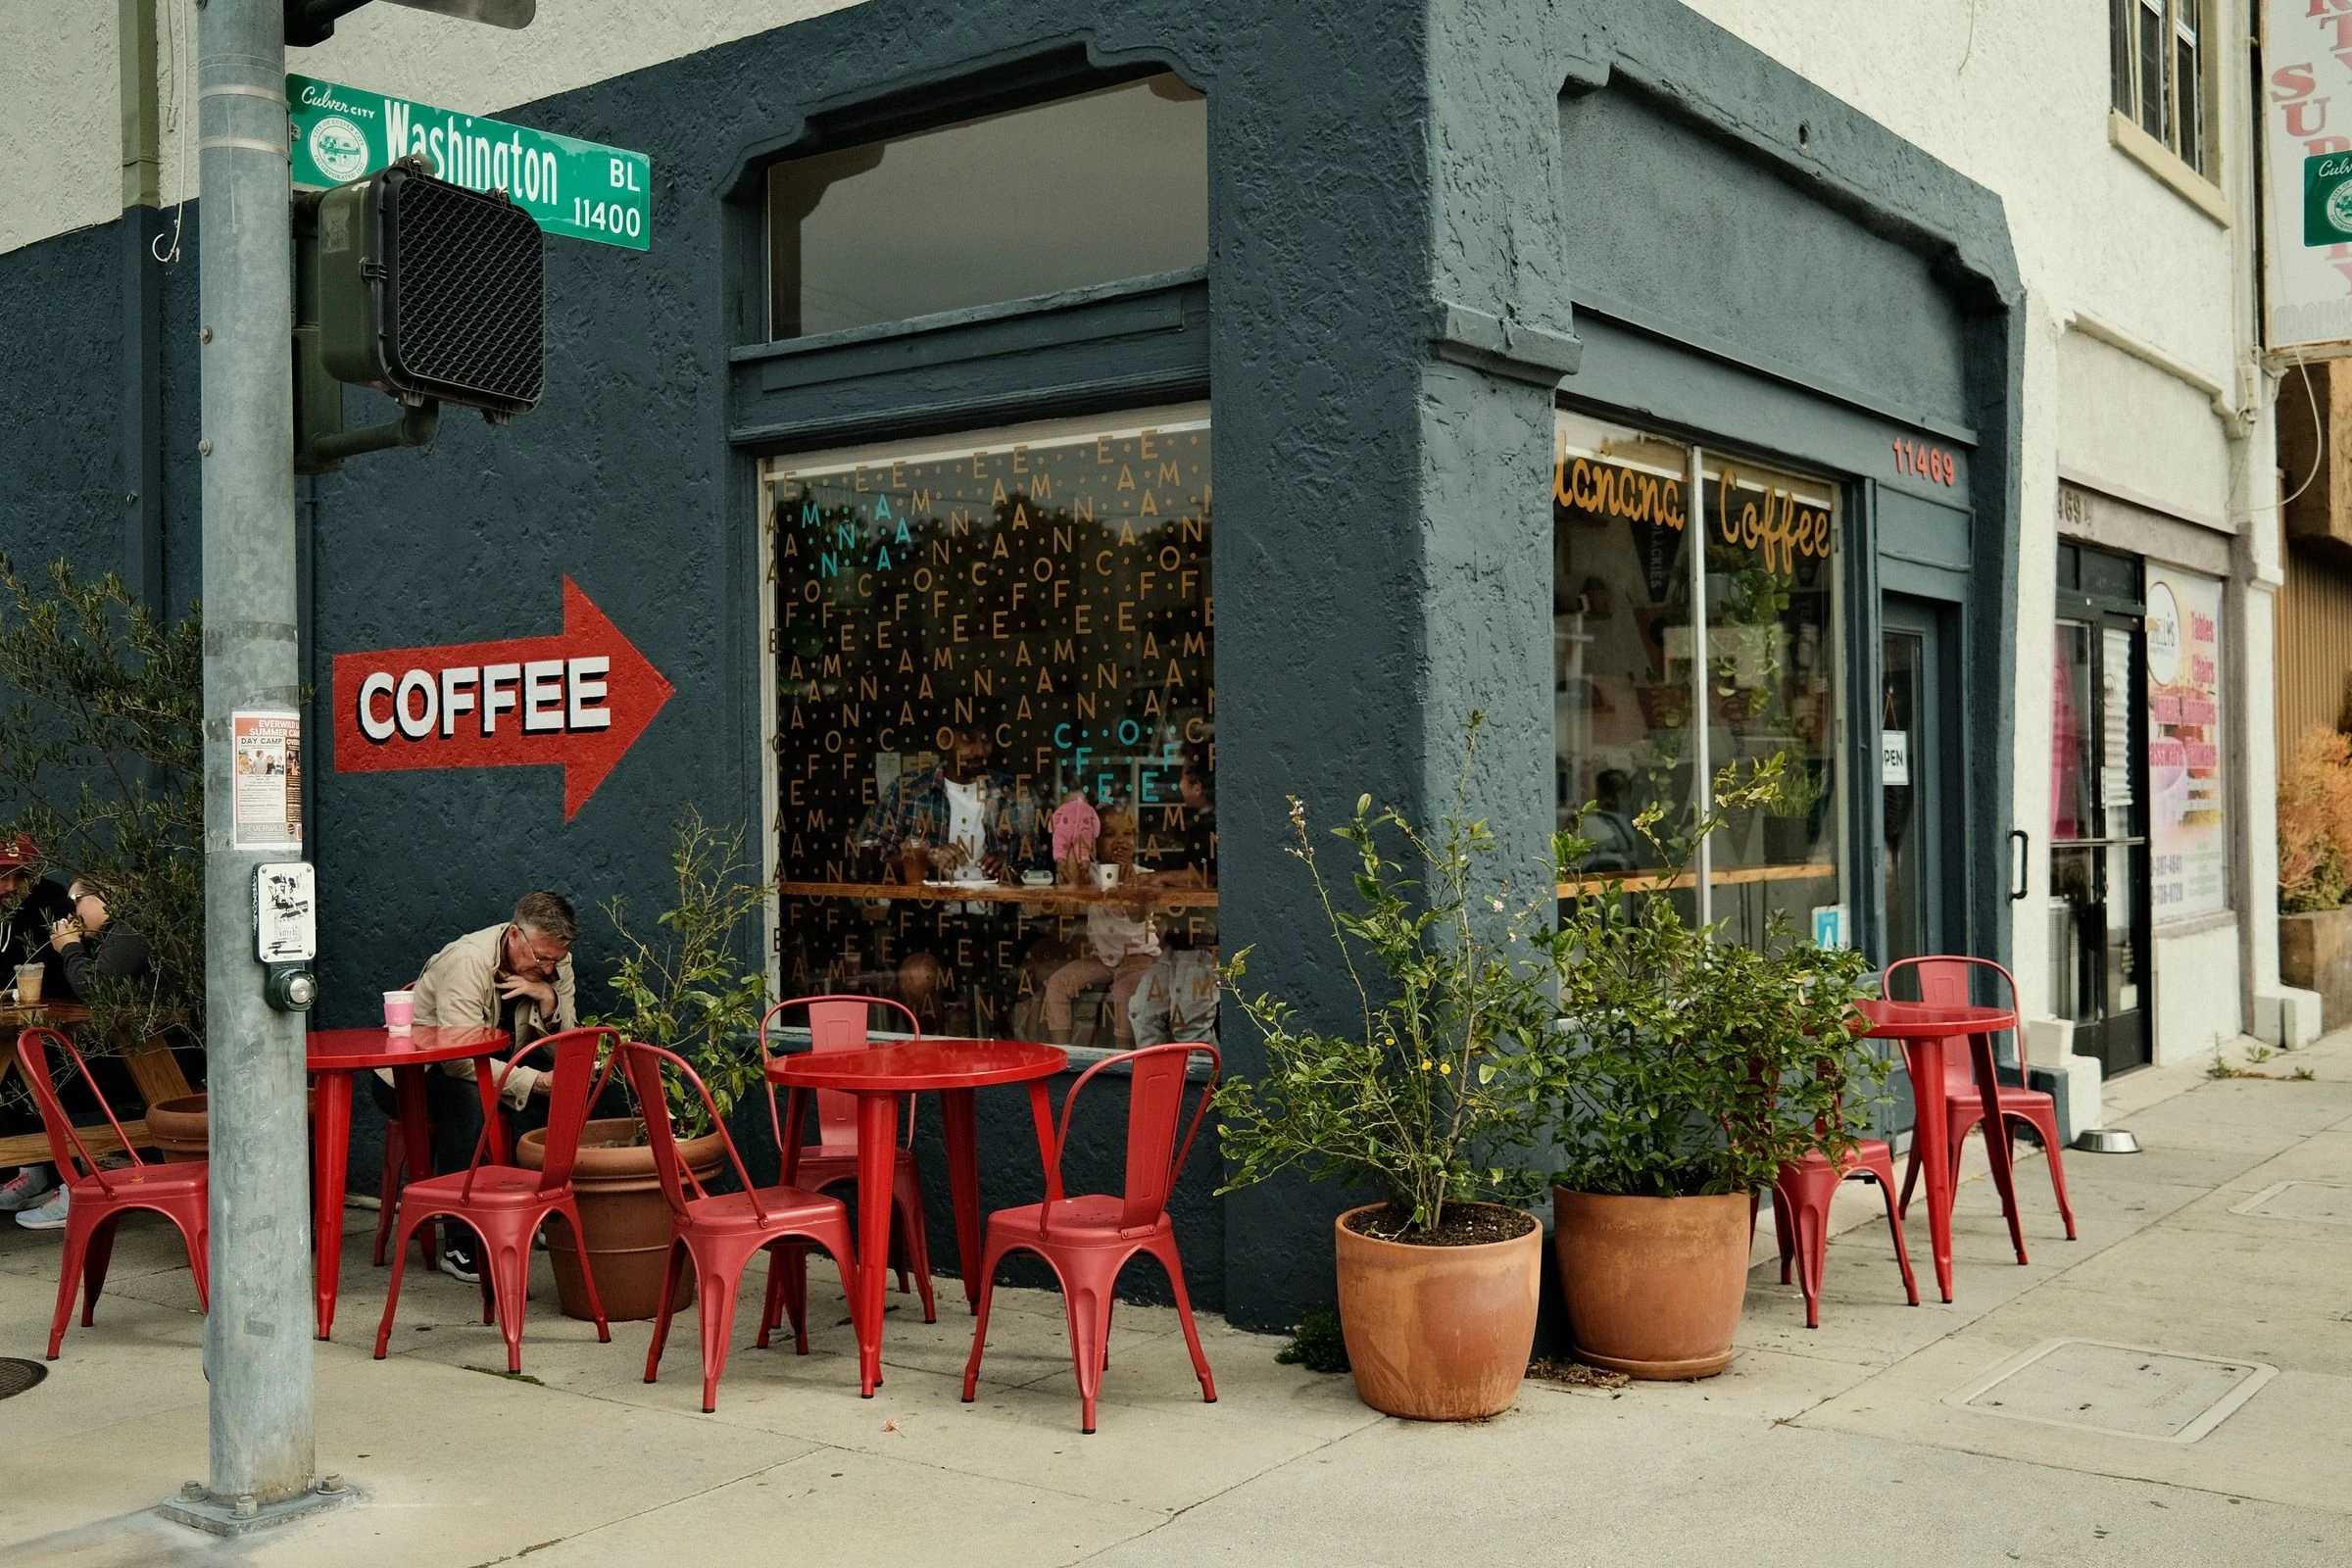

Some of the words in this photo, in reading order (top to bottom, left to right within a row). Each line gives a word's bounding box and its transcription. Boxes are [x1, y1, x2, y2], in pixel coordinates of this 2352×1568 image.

[301, 86, 349, 113] Culver
[350, 107, 374, 118] CITY
[384, 99, 558, 206] Washington
[610, 158, 641, 192] BL
[573, 198, 642, 238] 11400
[1891, 436, 1955, 487] 11469
[1719, 468, 1831, 575] Coffee
[359, 656, 611, 742] COFFEE
[249, 727, 288, 737] SUMMER
[259, 719, 295, 729] EVERWILD
[1883, 749, 1903, 766] PEN
